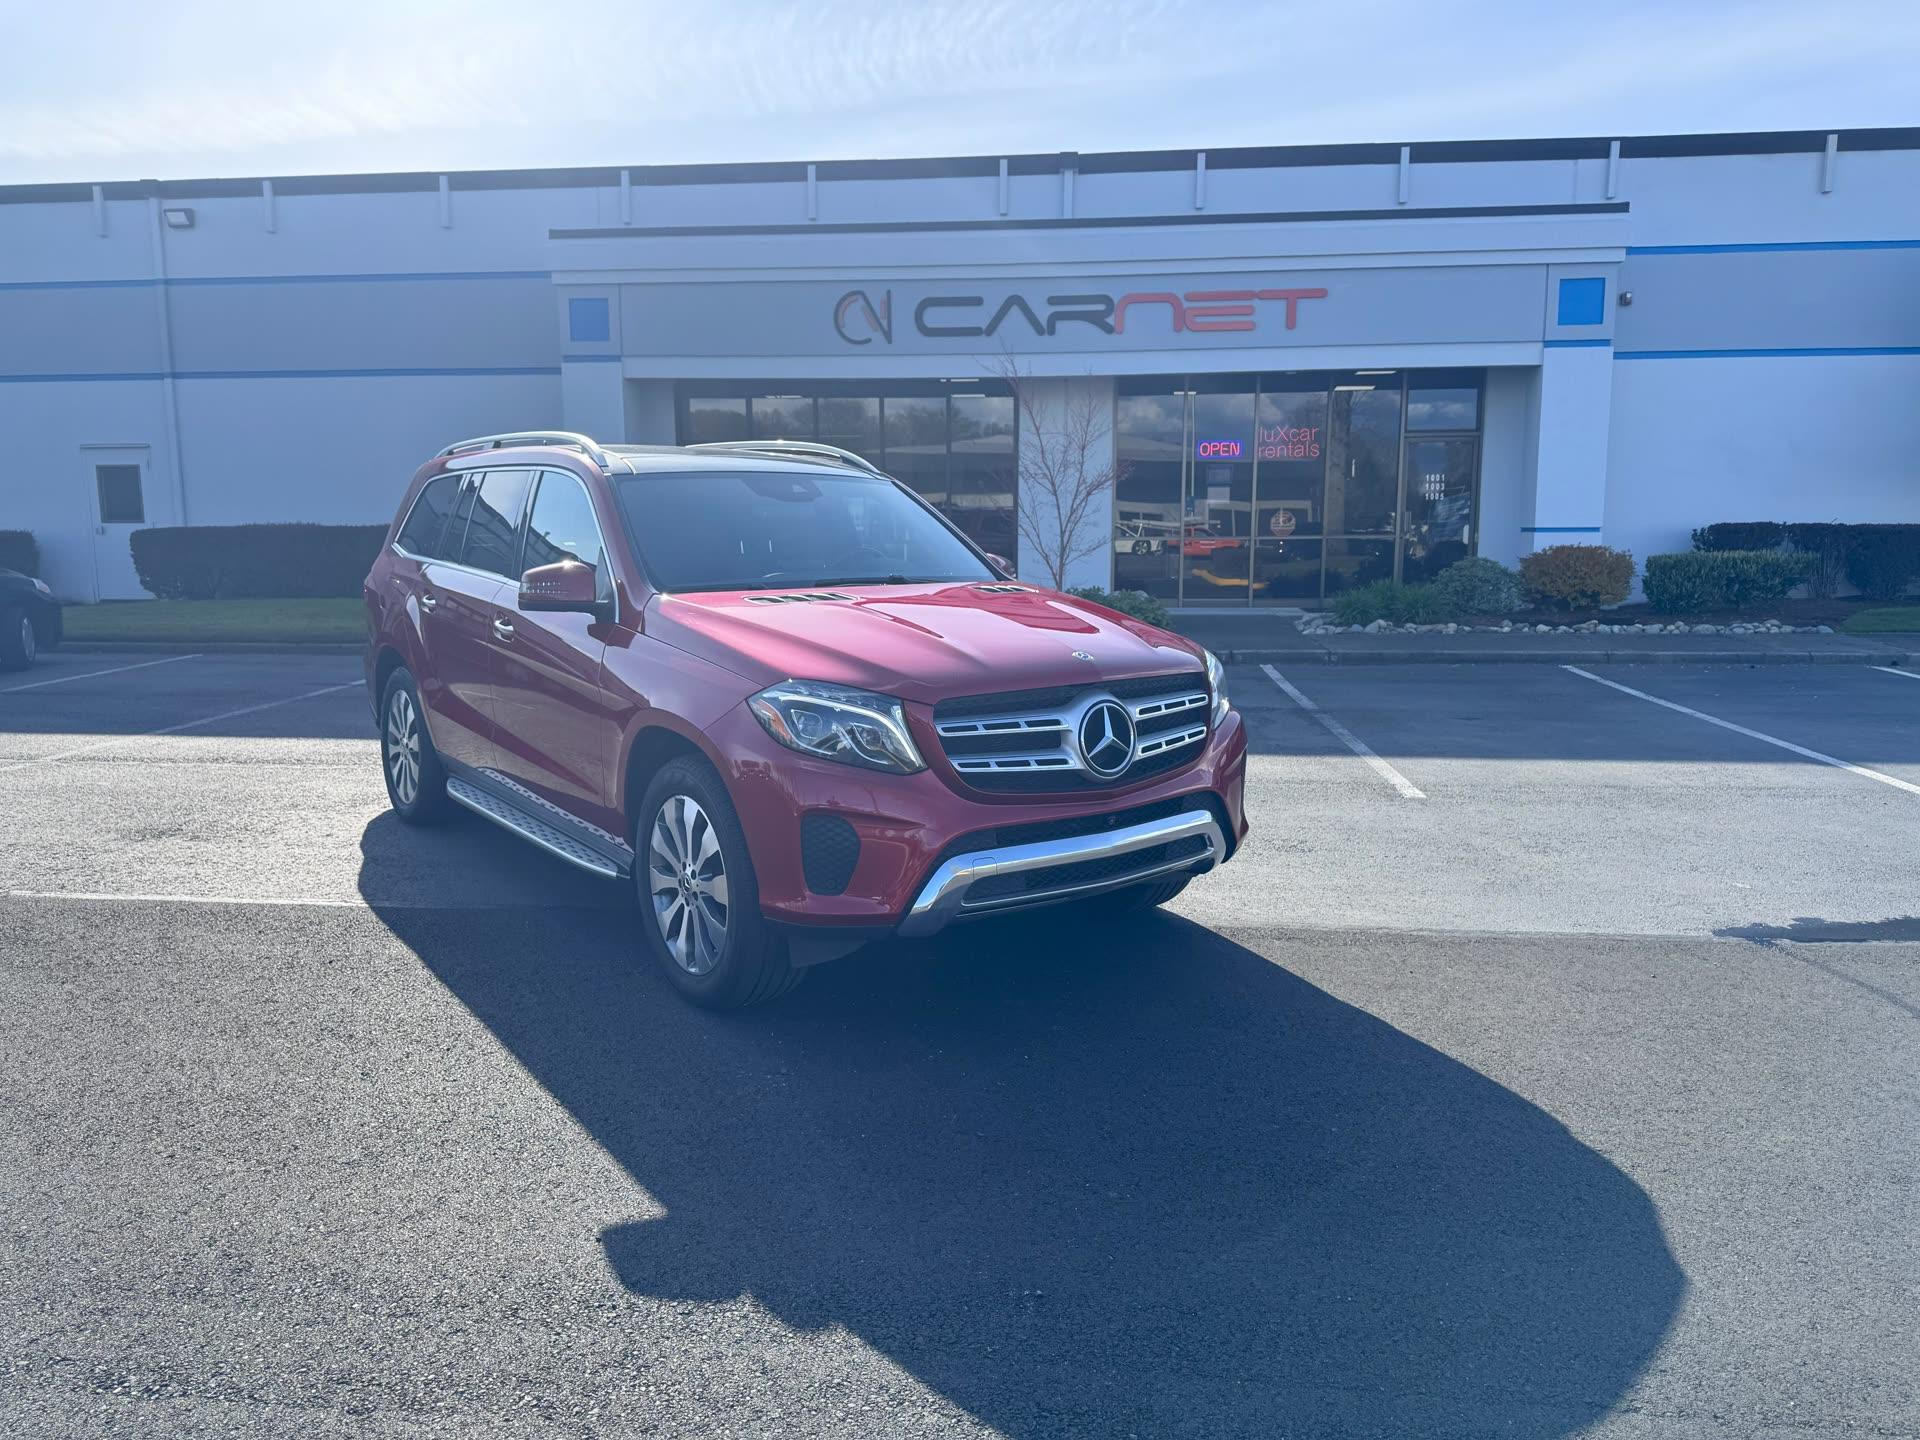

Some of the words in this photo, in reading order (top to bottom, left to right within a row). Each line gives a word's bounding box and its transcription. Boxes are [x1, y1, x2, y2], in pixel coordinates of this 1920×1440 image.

[1199, 442, 1241, 457] OPEN
[1258, 441, 1320, 459] rentals
[1425, 473, 1446, 482] 1001
